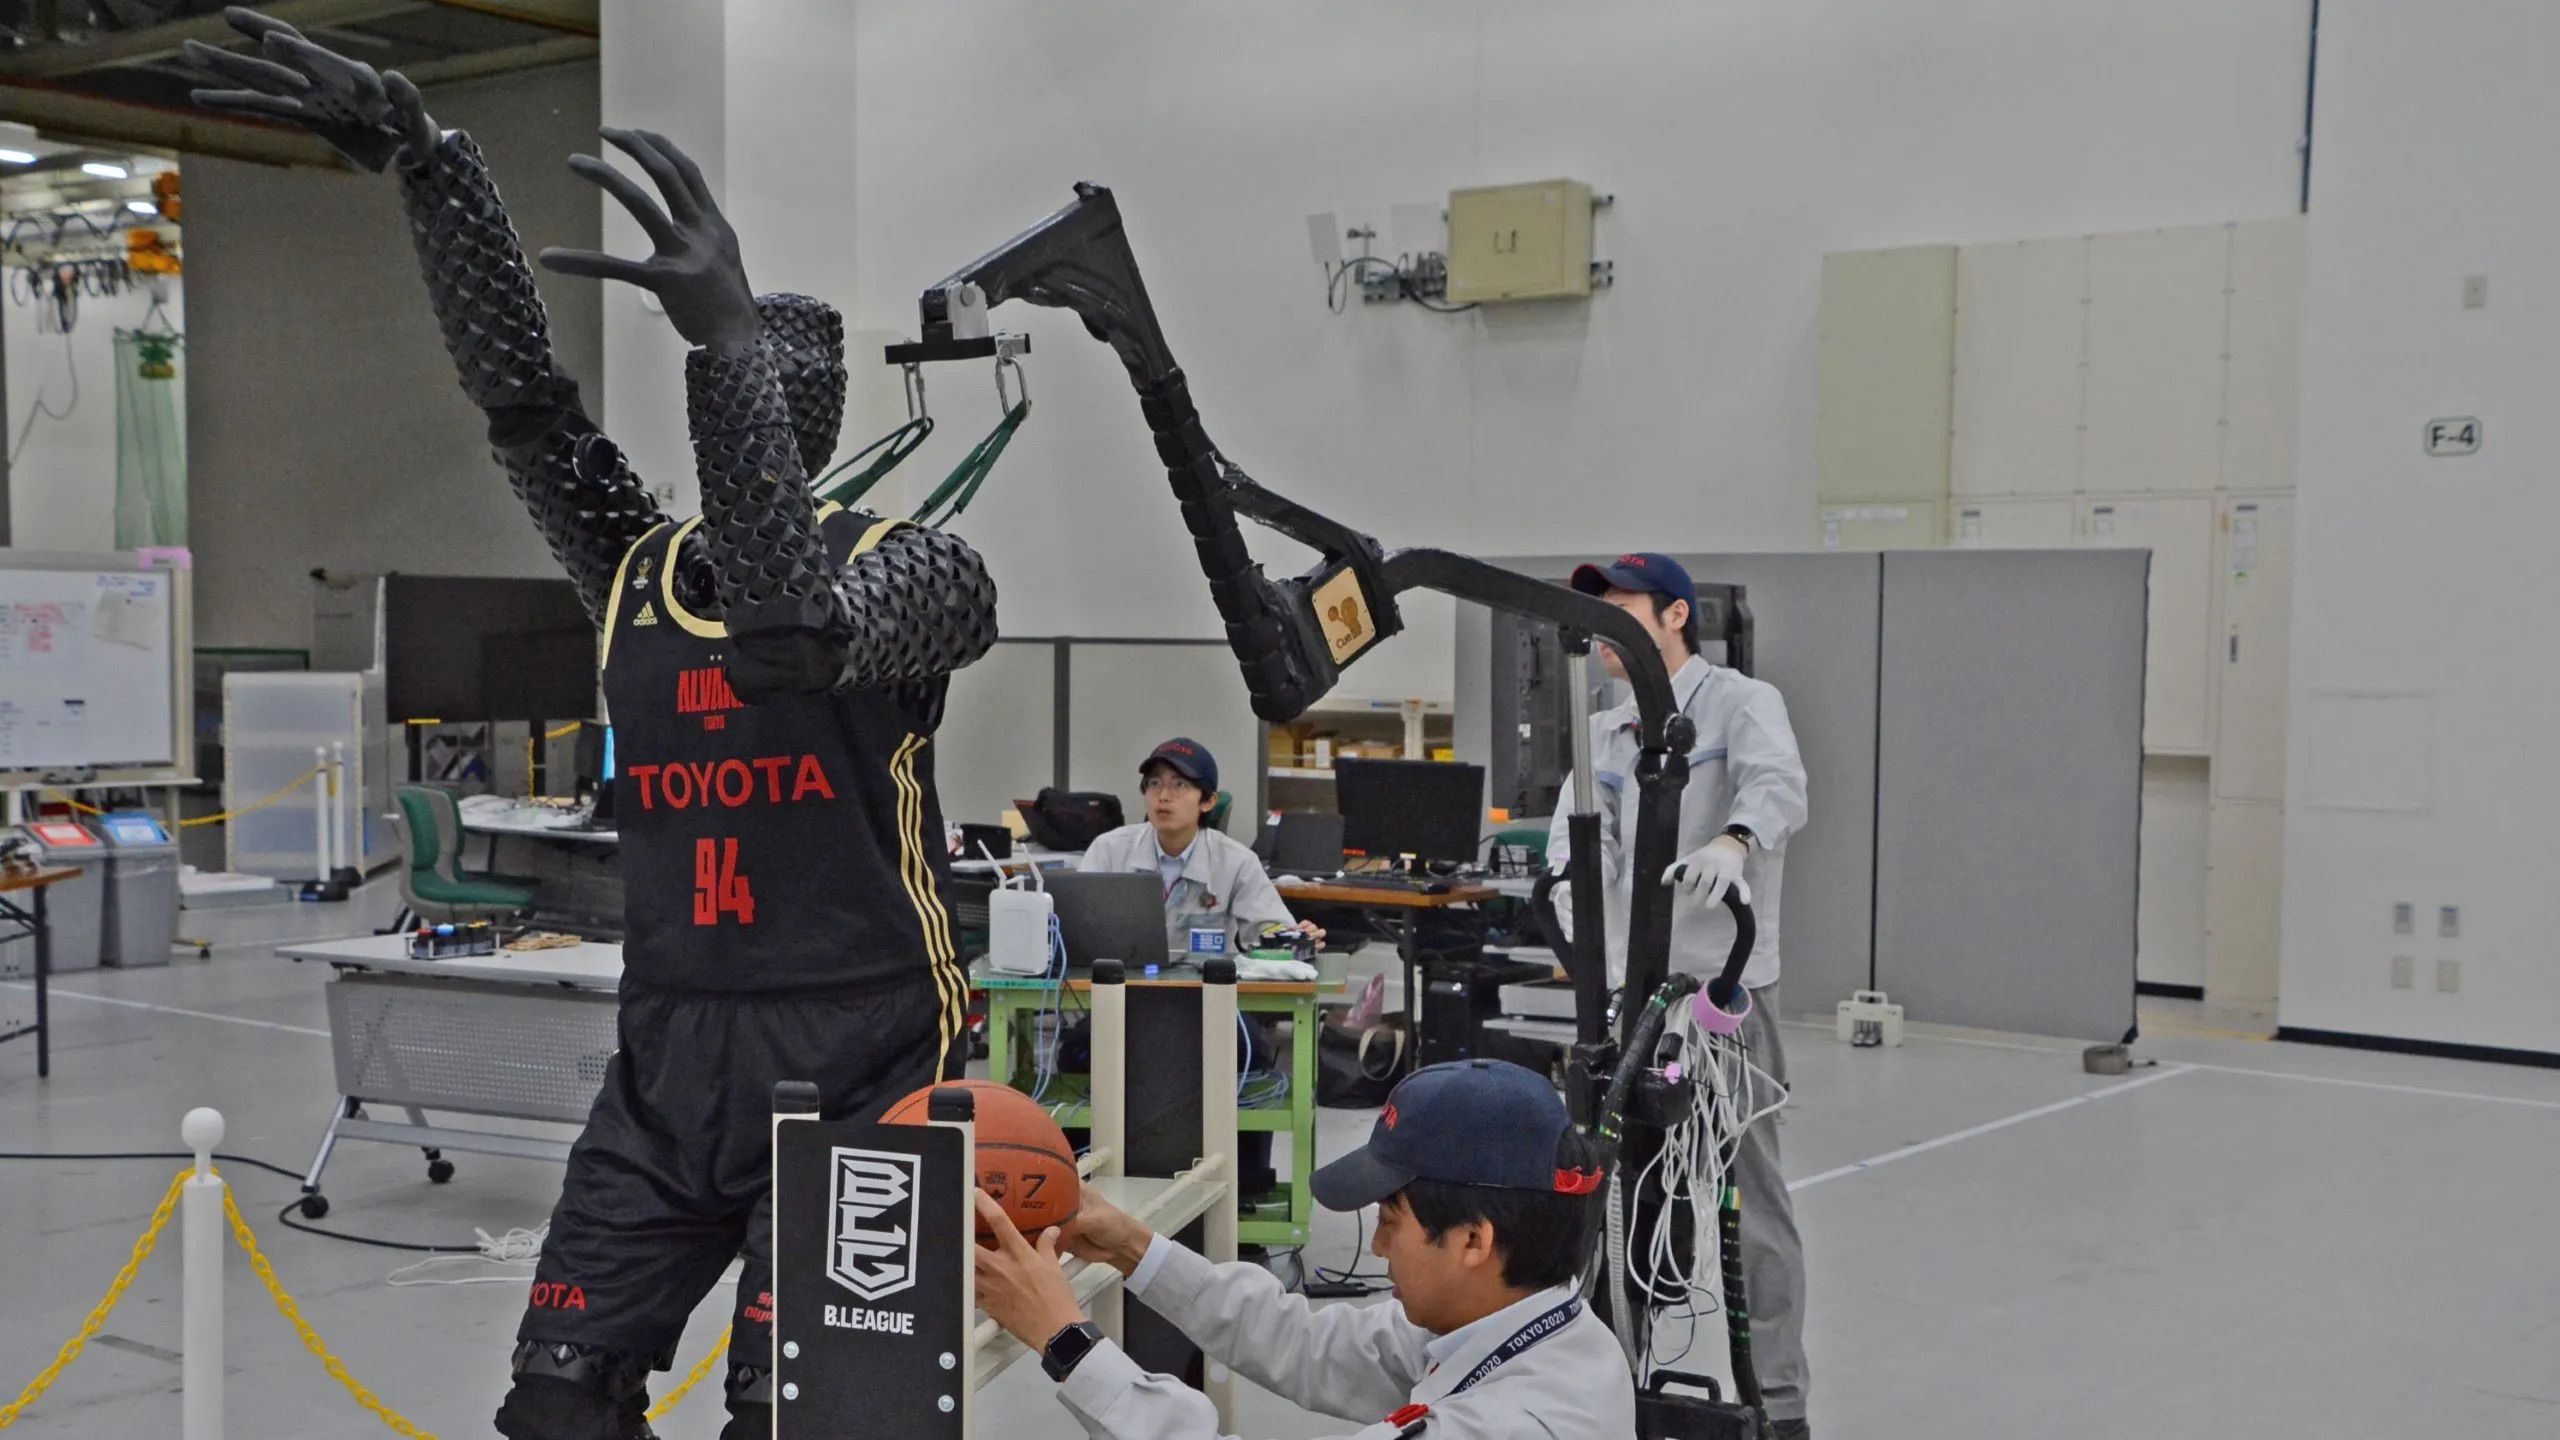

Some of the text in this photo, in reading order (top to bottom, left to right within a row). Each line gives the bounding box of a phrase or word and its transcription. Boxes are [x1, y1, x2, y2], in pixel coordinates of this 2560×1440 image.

[2431, 424, 2473, 448] F-4
[677, 666, 746, 713] ALVA
[628, 754, 836, 810] TOYOTA
[694, 837, 755, 926] 94
[1021, 1173, 1048, 1200] 7
[824, 1304, 915, 1336] B.LEAGUE
[1506, 1310, 1566, 1353] TOKYO 2020
